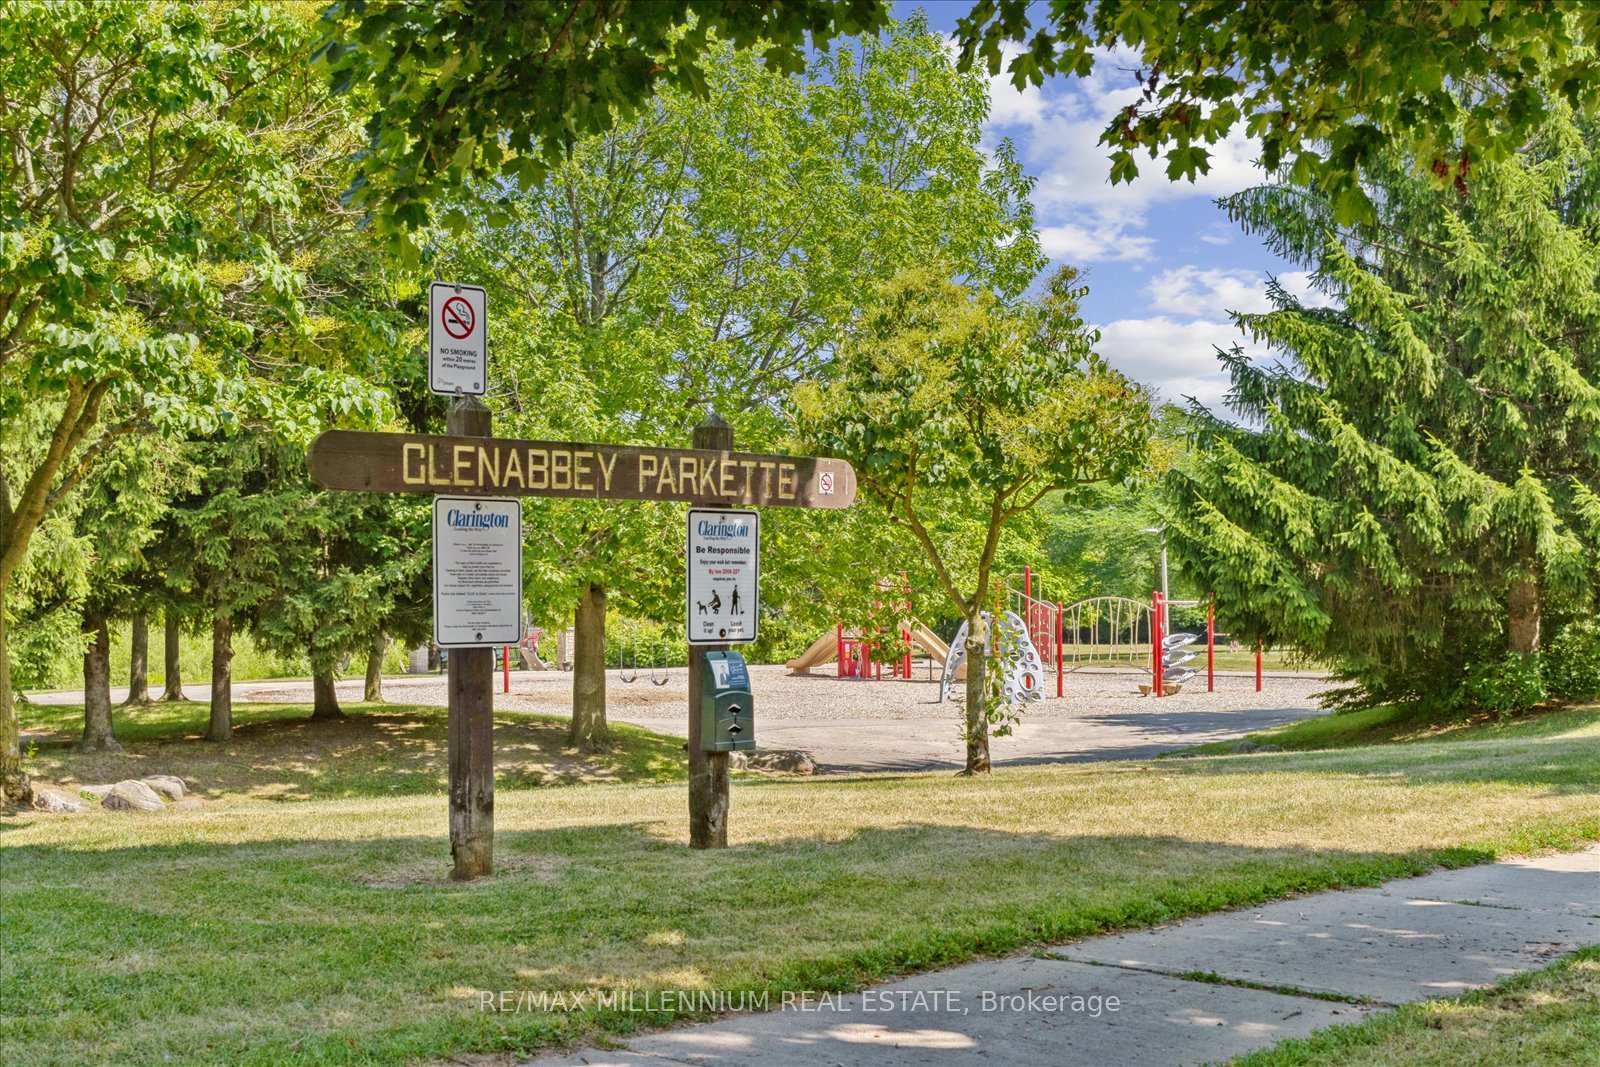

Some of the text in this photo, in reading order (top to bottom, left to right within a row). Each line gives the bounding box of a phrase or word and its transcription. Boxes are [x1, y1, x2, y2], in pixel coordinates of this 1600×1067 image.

[450, 349, 478, 357] SMOKING
[403, 443, 796, 499] GLENABBEY PARKETTE
[447, 509, 509, 528] Clarington
[698, 520, 748, 537] Clarington
[707, 546, 750, 554] Responsible
